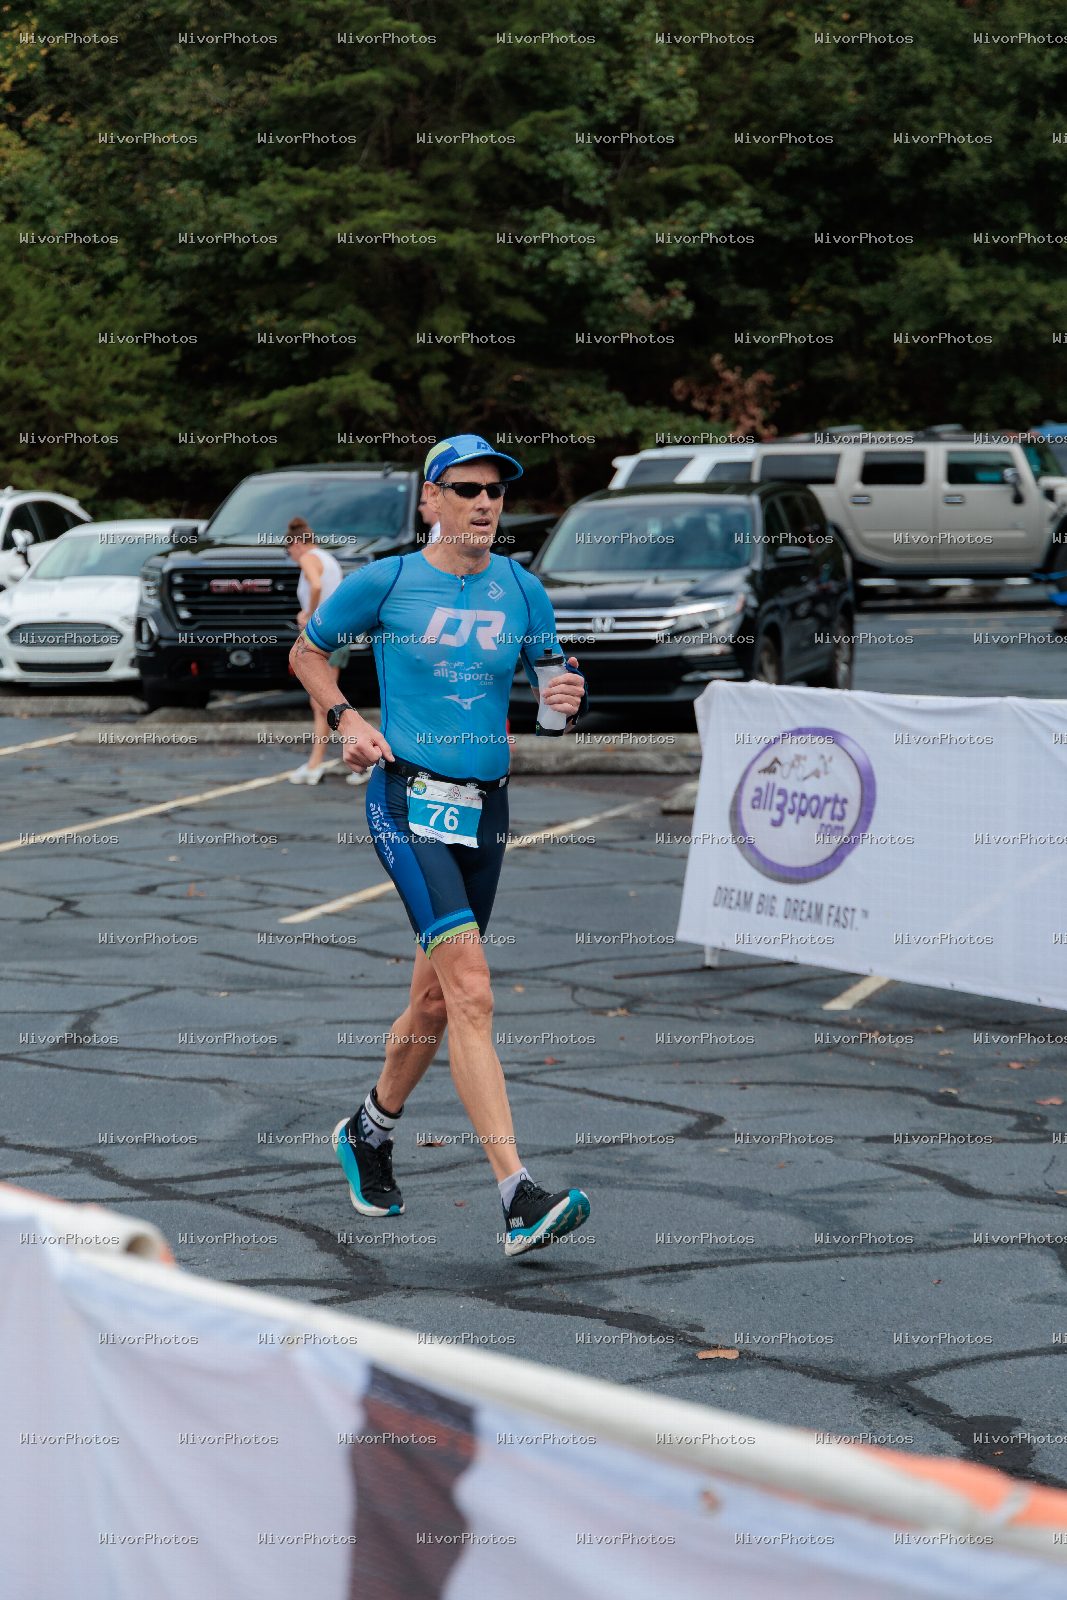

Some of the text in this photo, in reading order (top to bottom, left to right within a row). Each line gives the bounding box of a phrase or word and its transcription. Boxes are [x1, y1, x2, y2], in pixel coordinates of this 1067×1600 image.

[209, 578, 273, 594] GMC
[433, 668, 494, 683] all3sports
[426, 803, 460, 831] 76
[751, 782, 848, 827] all3sports
[713, 886, 754, 914] DREAM
[783, 897, 824, 926] DREAM
